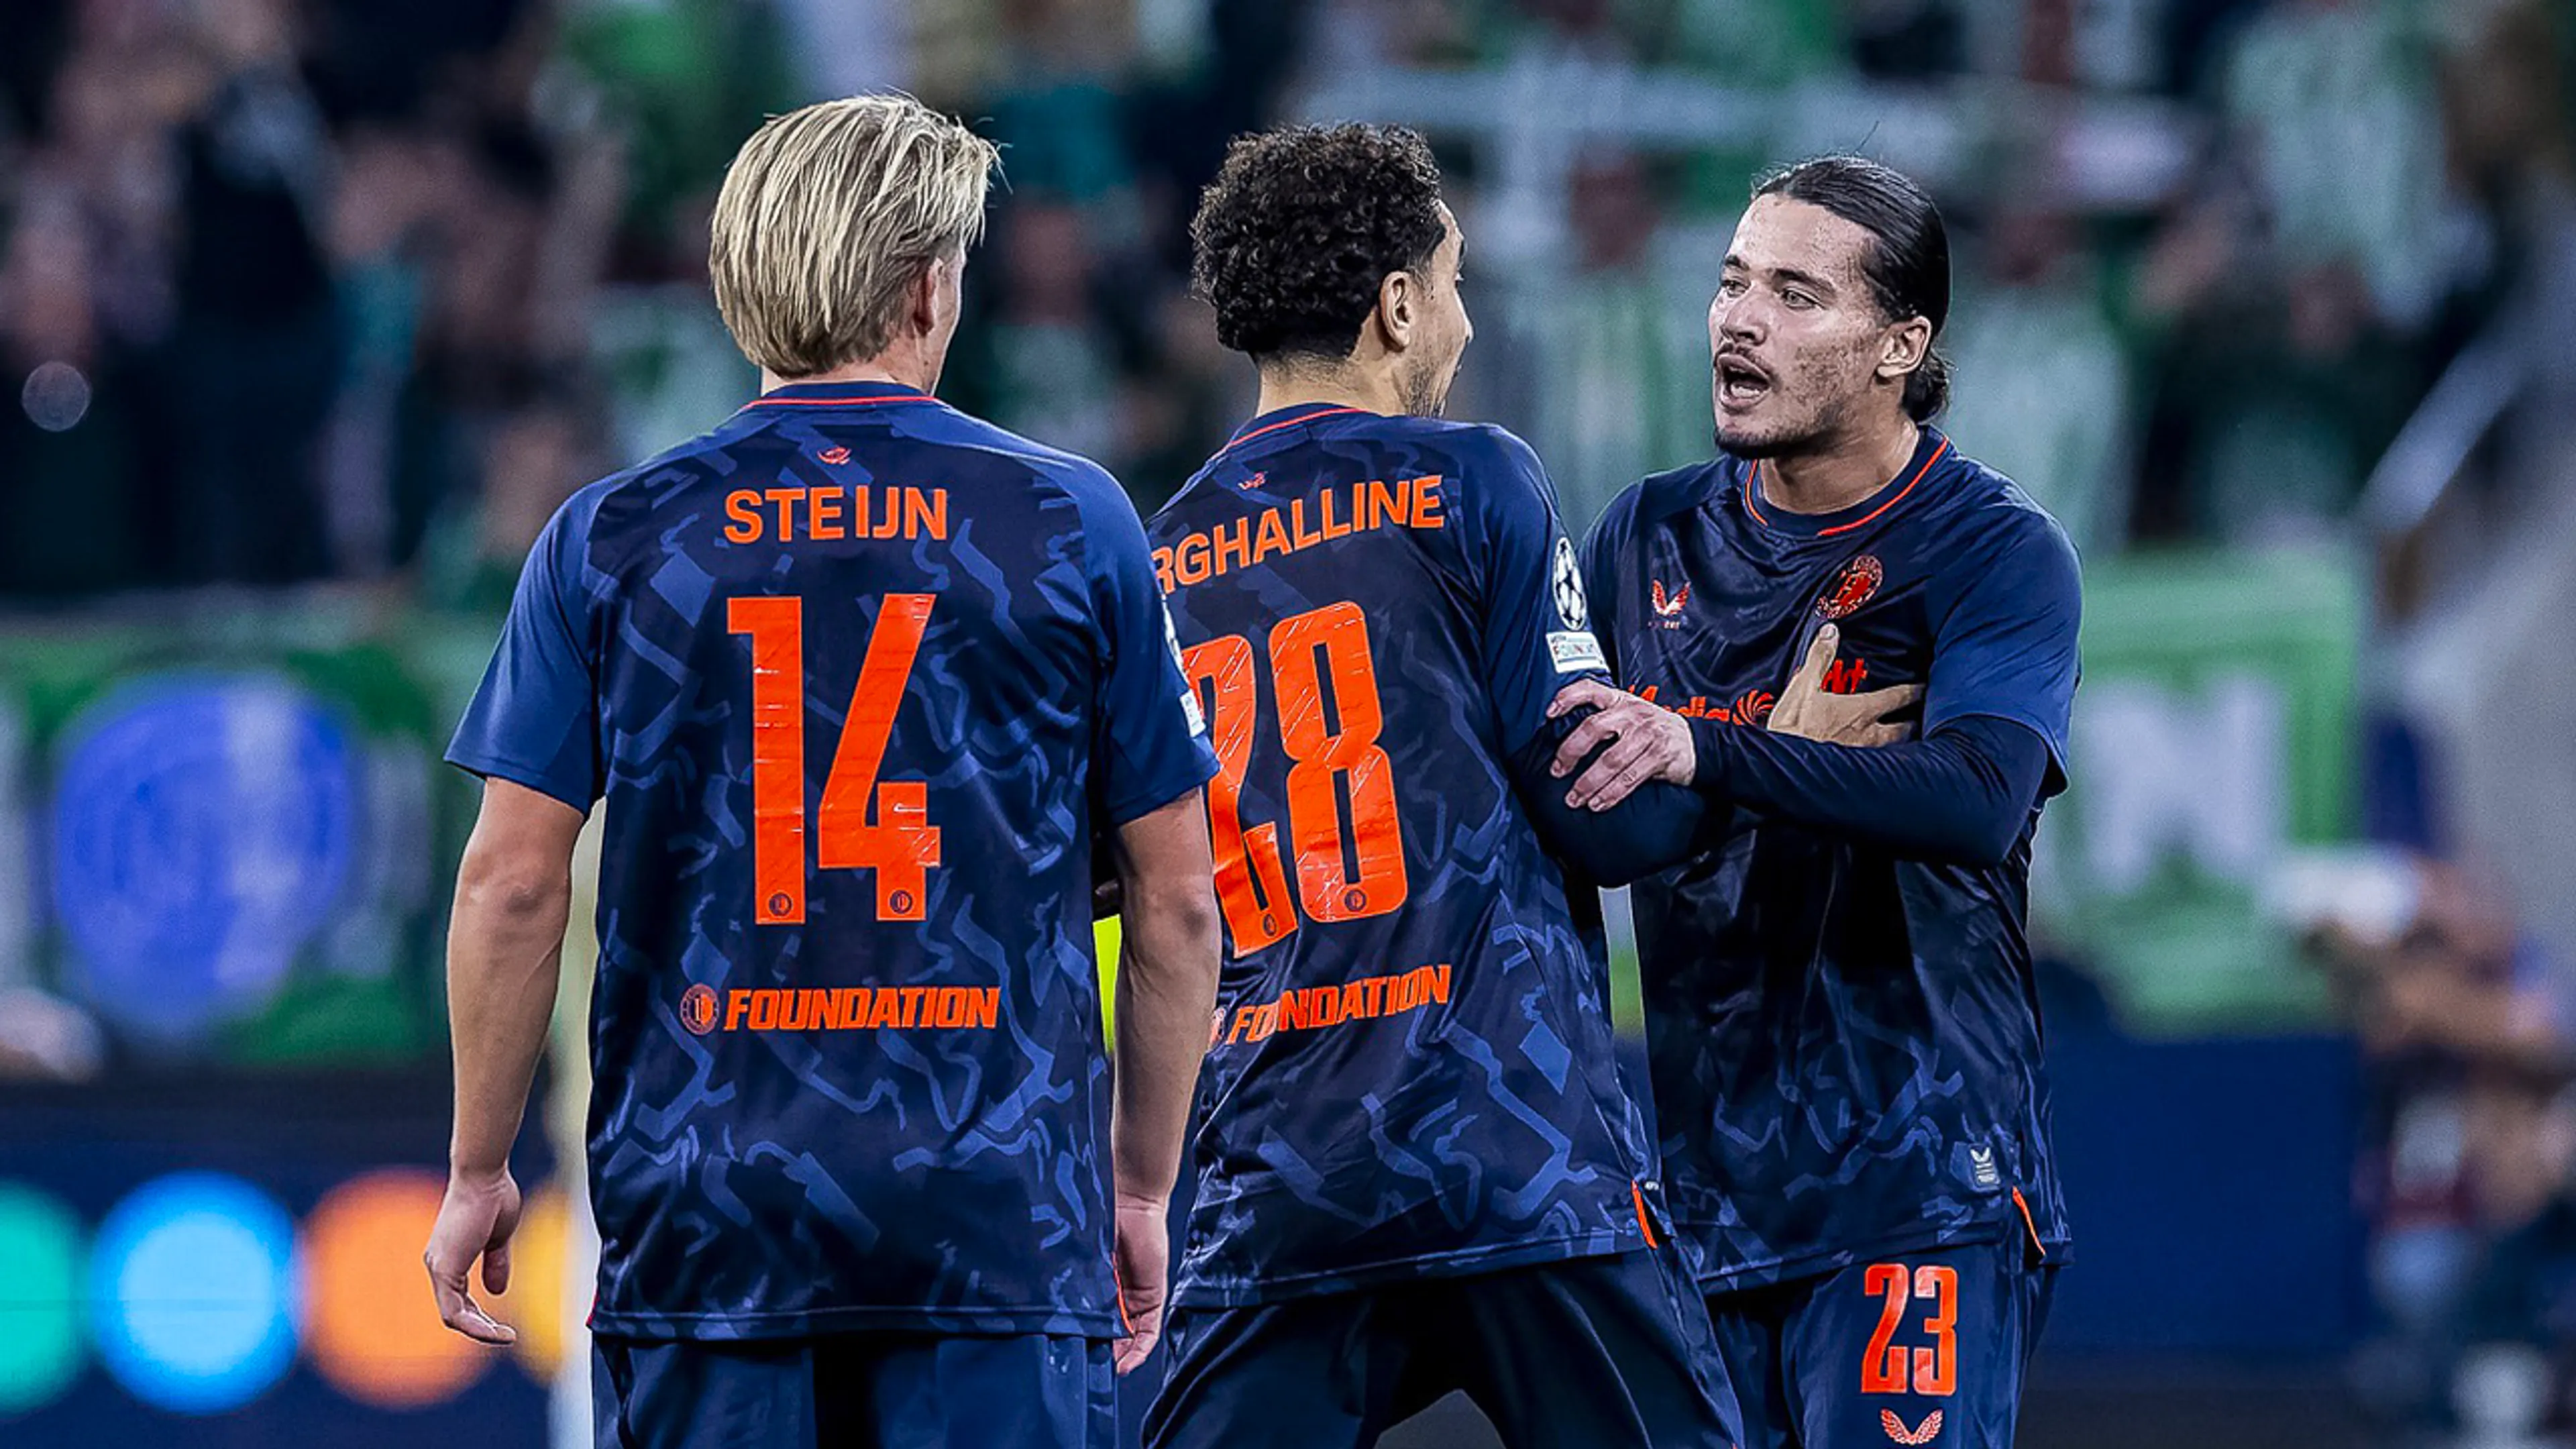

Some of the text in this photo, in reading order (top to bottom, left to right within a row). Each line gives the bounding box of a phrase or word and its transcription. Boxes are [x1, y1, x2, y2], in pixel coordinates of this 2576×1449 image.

[724, 485, 947, 543] STEIJN
[1150, 474, 1445, 594] RGHALLINE
[727, 593, 941, 924] 14
[1181, 601, 1409, 959] 28
[723, 986, 1001, 1031] FOUNDATION
[1226, 964, 1452, 1045] FONDATION
[1861, 1263, 1958, 1397] 23
